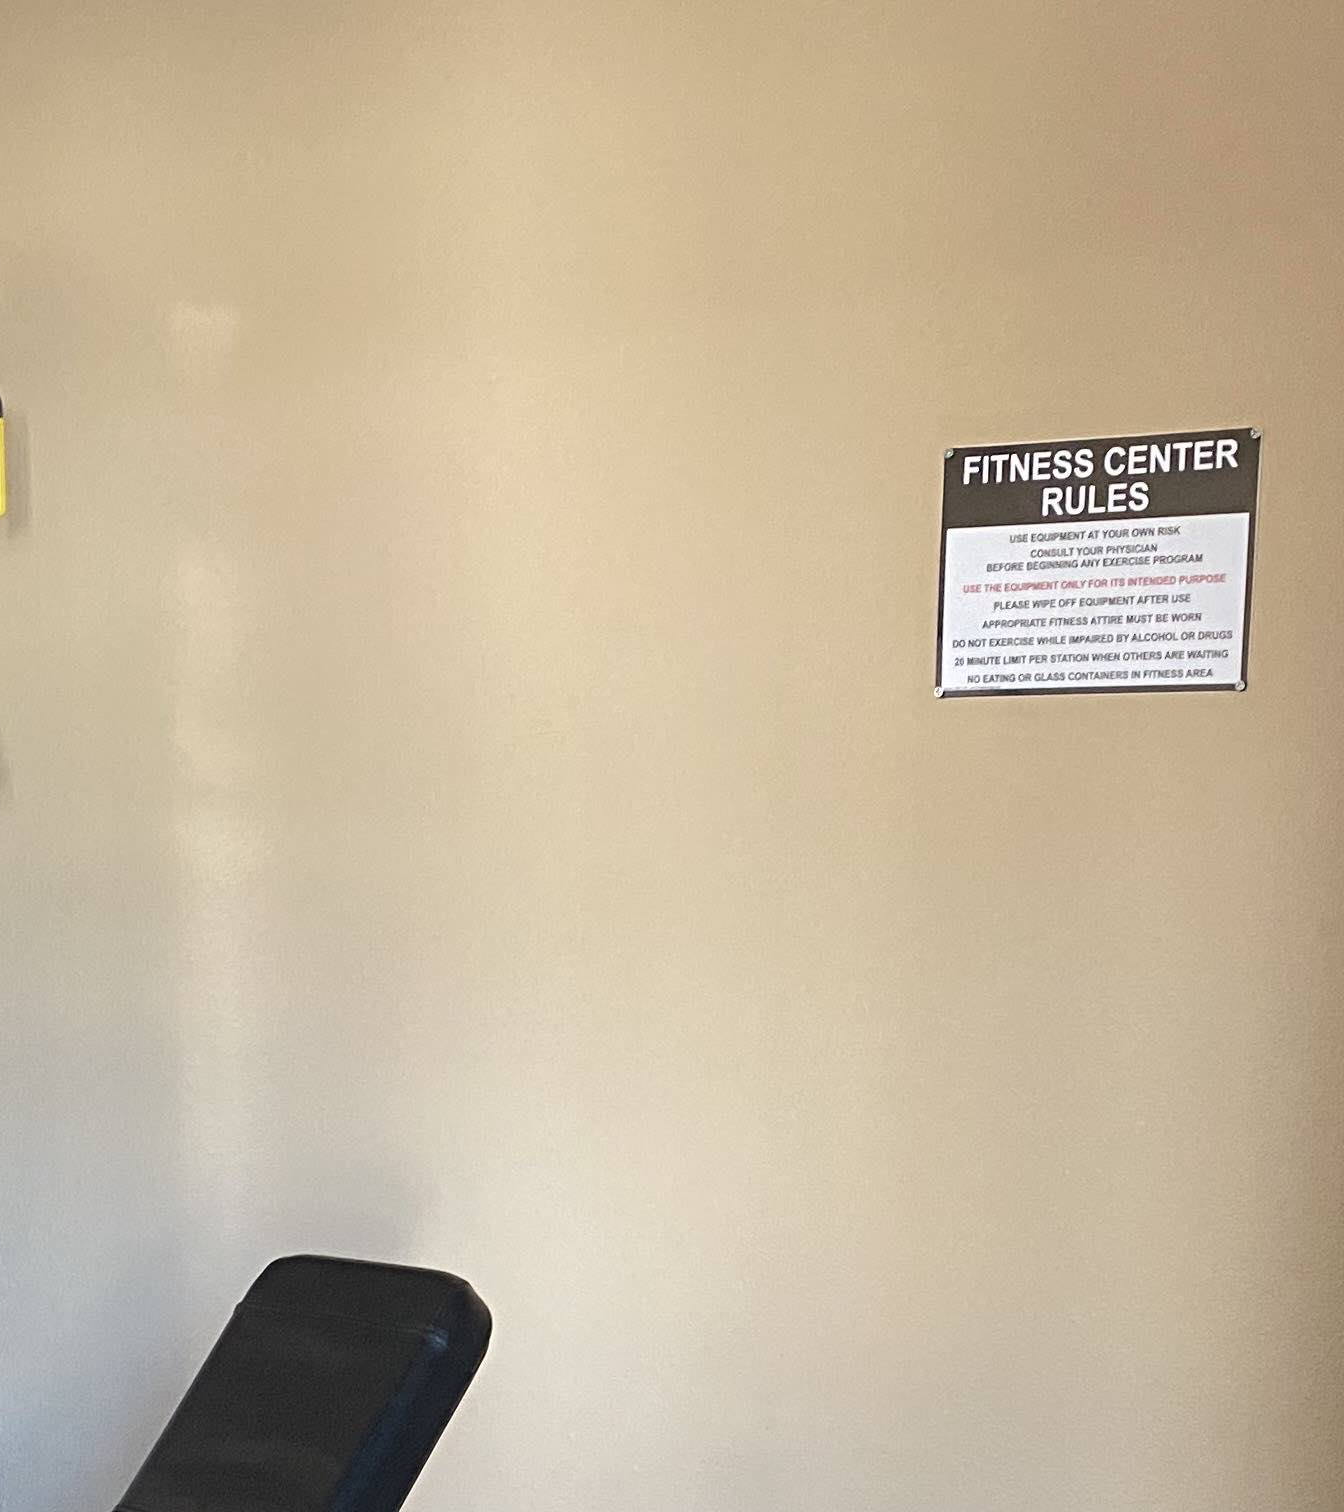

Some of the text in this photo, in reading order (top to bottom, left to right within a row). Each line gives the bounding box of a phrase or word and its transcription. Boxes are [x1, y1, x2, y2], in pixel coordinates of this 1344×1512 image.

[963, 439, 1239, 484] FITNESS CENTER
[1042, 482, 1150, 517] RULES
[1010, 526, 1181, 543] USE EQUIPMENT AT YOUR OWN RISK
[1030, 544, 1158, 558] CONSULT YOUR PHYSICIAN
[987, 553, 1203, 572] BEFORE BEGINNING ANY EXERCISE PROGRAM
[963, 573, 1227, 593] USE THE EQUIPMENT ONLY FOR ITS INTENDED PURPOSE
[993, 593, 1191, 611] PLEASE WIPE OFF EQUIPMENT AFTER USE
[982, 612, 1202, 629] APPROPRIATE FITNESS ATTIRE MUST BE WORN
[952, 629, 1233, 648] DO NOT EXERCISE WHILE IMPAIRED BY ALCOHOL OR DRUGS
[954, 648, 1229, 666] 20 MINUTE LIMIT PER STATION WHEN OTHERS ARE WAITING
[967, 668, 1214, 684] NO EATING OR GLASS CONTAINERS IN FITNESS AREA
